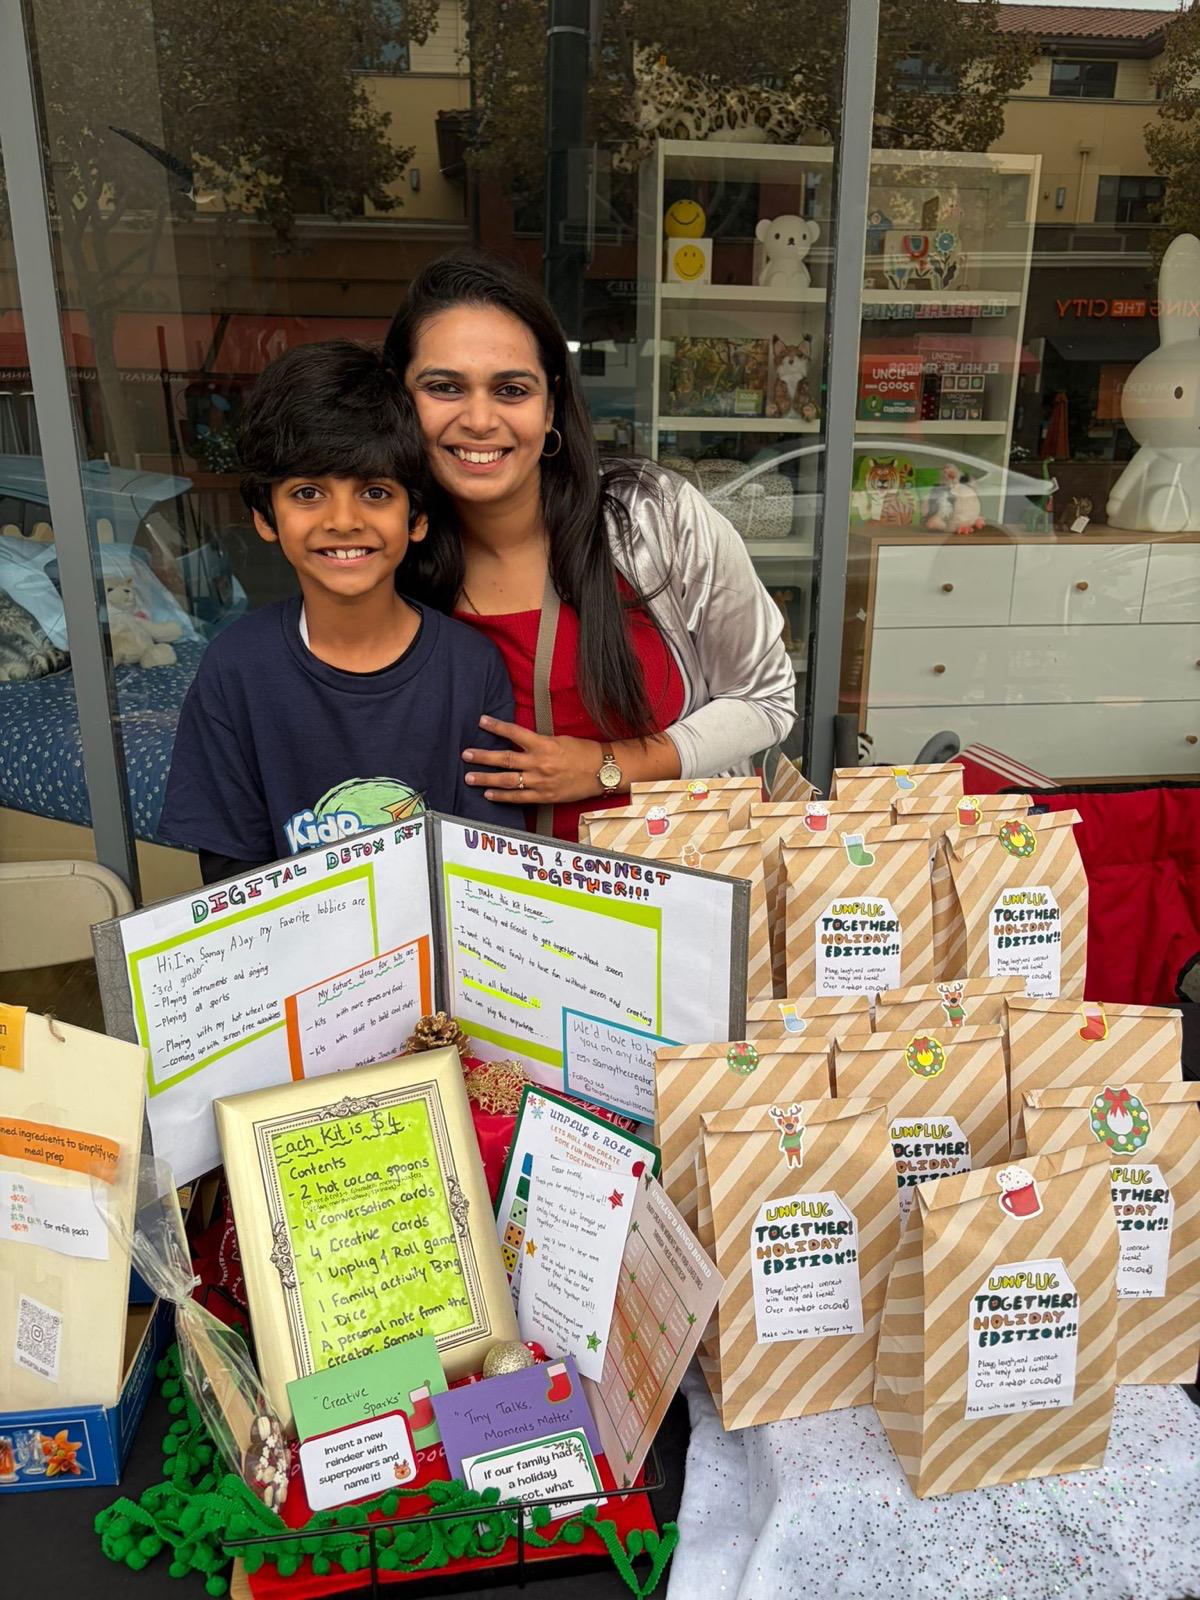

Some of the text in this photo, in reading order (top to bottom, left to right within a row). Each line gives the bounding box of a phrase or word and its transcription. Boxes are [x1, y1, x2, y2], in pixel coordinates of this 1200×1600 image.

[872, 368, 906, 380] UNCLE
[878, 382, 916, 392] GOOSE
[464, 828, 672, 886] UNPLUG & CONNECT
[191, 823, 423, 924] DIGITAL DETOX KIT
[522, 863, 650, 900] TOGETHER!!!
[832, 902, 885, 917] UNPLUG
[1003, 892, 1048, 906] UNPLUG
[822, 918, 899, 932] TOGETHER!
[994, 908, 1059, 922] TOGETHER!
[200, 947, 225, 962] Samay
[260, 926, 272, 942] my
[352, 897, 366, 906] are
[821, 933, 890, 945] HOLIDAY
[994, 922, 1052, 936] HOLIDAY
[998, 931, 1060, 949] EDITION!!
[825, 944, 900, 958] EDITION!!
[192, 977, 228, 996] instruments
[234, 970, 244, 981] and
[249, 962, 269, 978] singing
[210, 992, 230, 1008] sports
[197, 1026, 213, 1038] with
[216, 1020, 225, 1030] my
[232, 1011, 242, 1022] hot
[246, 1004, 264, 1016] wheel
[266, 1000, 278, 1009] cars
[574, 1020, 642, 1050] We'd love to
[601, 1045, 612, 1055] on
[616, 1051, 632, 1064] any
[636, 1056, 656, 1070] ideas
[272, 1134, 314, 1159] Each
[320, 1123, 346, 1144] Kit
[350, 1122, 363, 1135] is
[550, 1108, 633, 1158] UNPLUG & ROLL
[891, 1123, 952, 1139] UNPLUG
[19, 1128, 106, 1160] ingredients to simplify
[24, 1146, 64, 1164] meal prep
[551, 1124, 621, 1165] LETS ROLL AND CREATE
[554, 1136, 612, 1171] SOME FUN MOMENTS
[891, 1142, 969, 1158] OGETHER!
[290, 1157, 346, 1180] Contents
[896, 1158, 959, 1174] OLIDAY
[1110, 1168, 1153, 1185] PLUG
[300, 1157, 430, 1200] 2 hot cocoa spoons
[1111, 1189, 1169, 1203] ETHER!
[305, 1219, 316, 1231] 4
[321, 1199, 396, 1226] conversation
[400, 1184, 435, 1203] cards
[766, 1201, 833, 1221] UNPLUG
[1114, 1205, 1157, 1216] IDAY
[755, 1221, 853, 1243] TOGETHER!
[1117, 1217, 1168, 1231] ION!!
[311, 1214, 430, 1260] 4 Creative cards
[329, 1256, 380, 1280] Unplug
[392, 1242, 420, 1258] Roll
[424, 1233, 456, 1255] game
[675, 1224, 694, 1250] BINGO
[692, 1248, 712, 1278] BOARD
[757, 1238, 842, 1260] HOLIDAY
[764, 1250, 857, 1276] EDITION!!
[332, 1285, 377, 1308] Family
[381, 1267, 427, 1292] activity
[429, 1258, 462, 1276] Bing
[988, 1272, 1059, 1291] UNPLUG
[975, 1293, 1078, 1313] TOGETHER!
[322, 1297, 468, 1352] A personal note from the
[334, 1309, 367, 1327] Dice
[973, 1311, 1066, 1331] HOLIDAY
[979, 1323, 1077, 1348] EDITION!!
[325, 1440, 355, 1455] Invent
[364, 1431, 383, 1443] new
[484, 1423, 535, 1441] Moments
[326, 1443, 388, 1468] reindeer with
[484, 1448, 573, 1480] If our family had
[319, 1452, 400, 1485] superpowers and
[508, 1468, 558, 1489] a holiday
[344, 1473, 381, 1491] name it!
[545, 1480, 574, 1495] what
